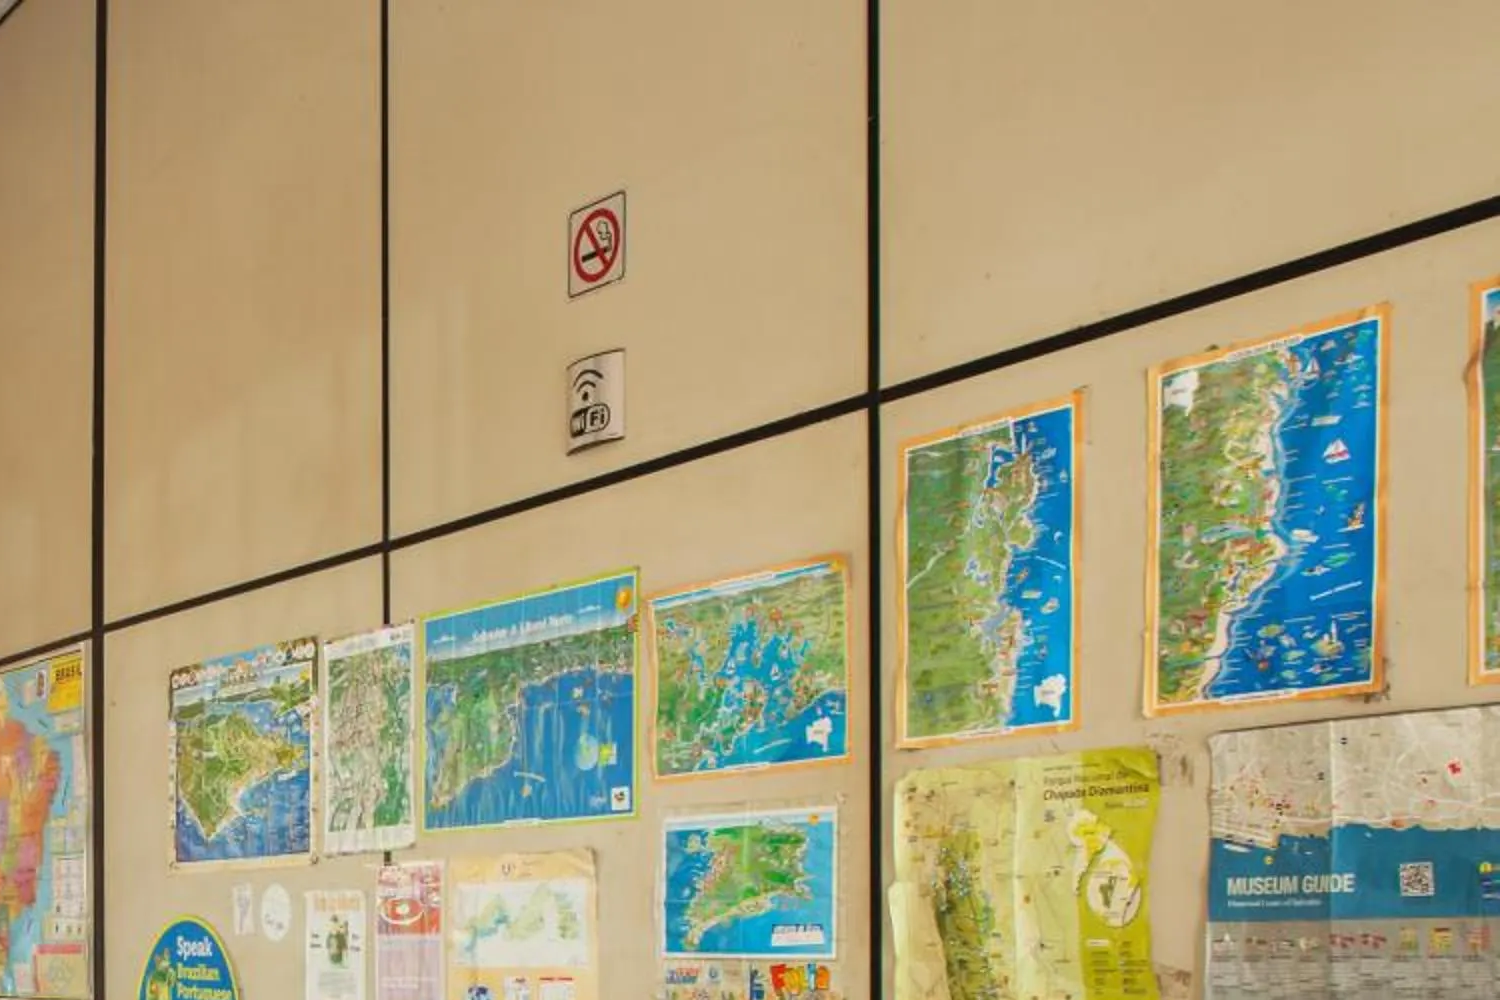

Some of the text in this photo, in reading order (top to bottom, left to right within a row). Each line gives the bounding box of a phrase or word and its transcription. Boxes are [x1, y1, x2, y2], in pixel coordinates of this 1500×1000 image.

[1227, 872, 1357, 896] MUSEUM GUIDE
[176, 935, 213, 960] Speak
